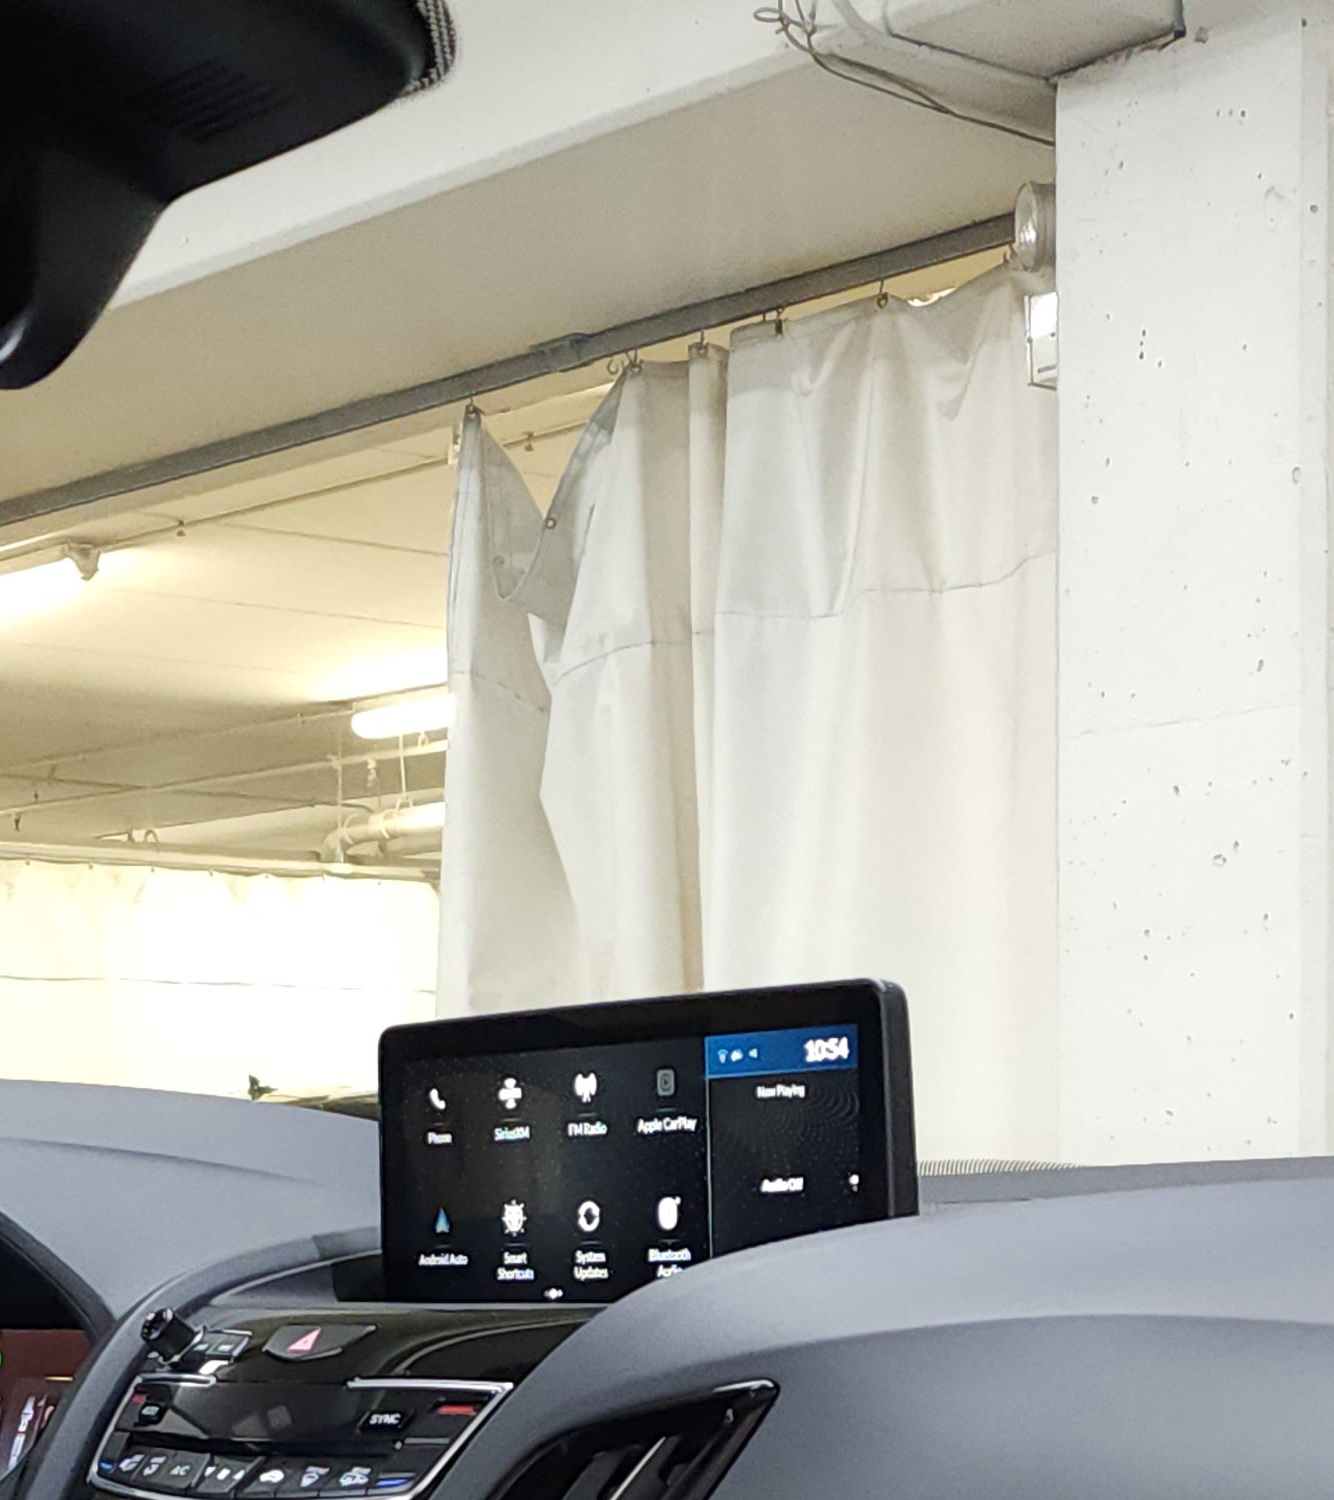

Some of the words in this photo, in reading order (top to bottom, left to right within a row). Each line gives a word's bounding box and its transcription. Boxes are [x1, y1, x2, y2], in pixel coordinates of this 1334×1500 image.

[583, 1121, 608, 1135] Radio
[637, 1118, 662, 1135] Apple
[662, 1115, 698, 1132] CarPlay
[418, 1253, 450, 1266] Android
[450, 1253, 469, 1265] Auto
[575, 1249, 606, 1265] System
[573, 1266, 609, 1281] Updates
[369, 1412, 402, 1425] SYNC
